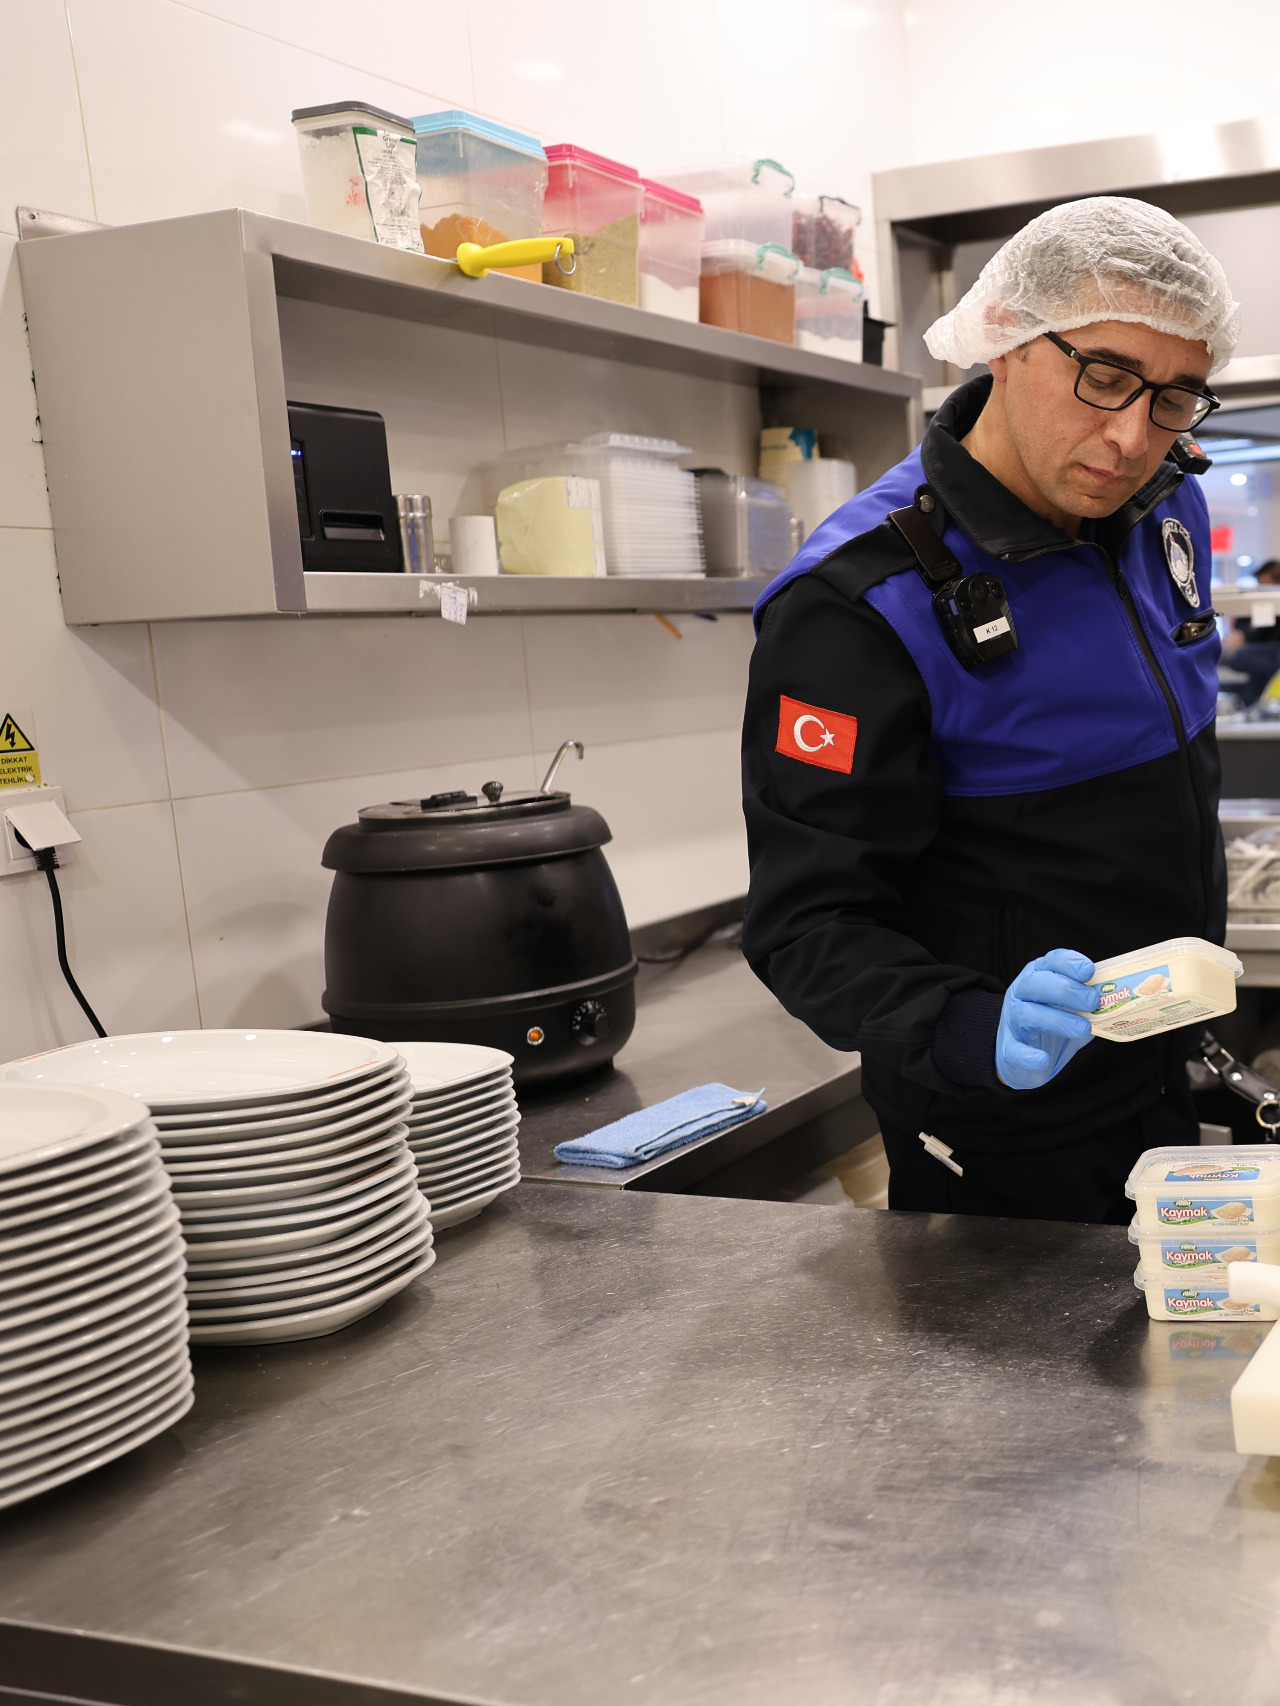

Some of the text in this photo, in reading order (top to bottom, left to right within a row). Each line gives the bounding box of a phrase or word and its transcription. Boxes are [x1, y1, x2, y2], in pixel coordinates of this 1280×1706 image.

[1, 756, 27, 764] DİKKAT
[1160, 1206, 1208, 1219] Kaymak
[1166, 1250, 1213, 1262] Kaymak
[1167, 1297, 1214, 1308] Kaymak
